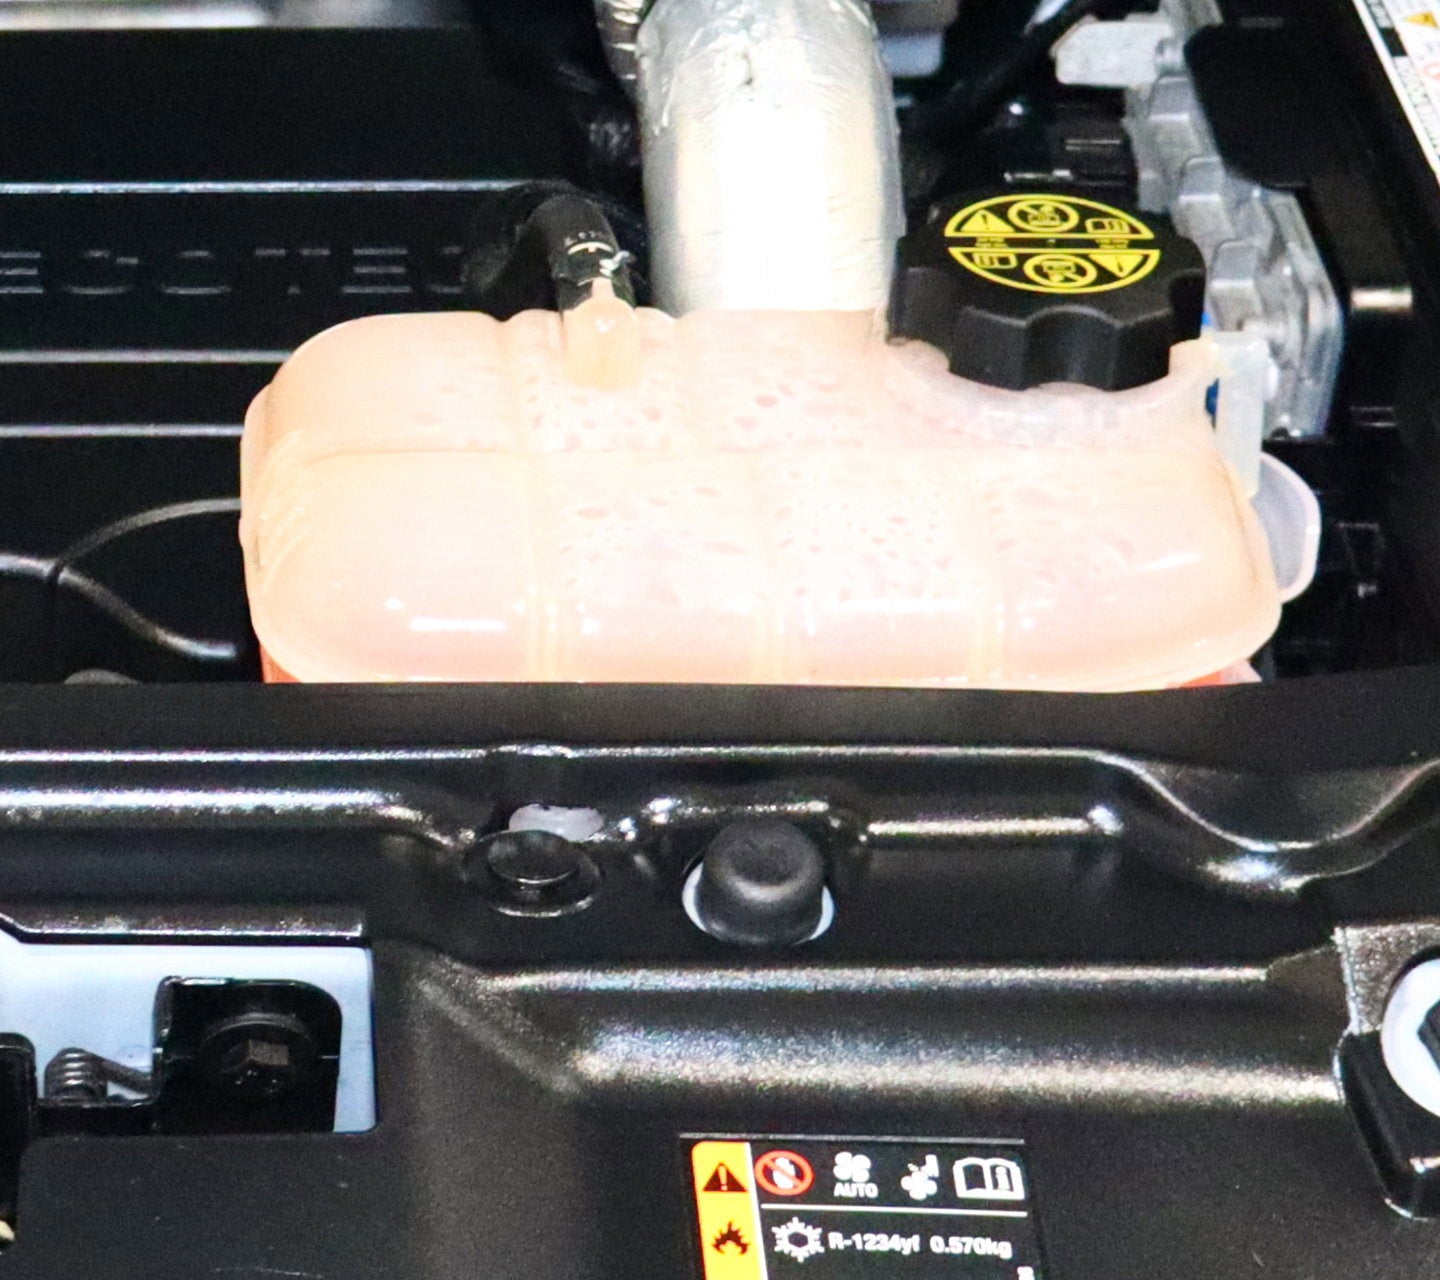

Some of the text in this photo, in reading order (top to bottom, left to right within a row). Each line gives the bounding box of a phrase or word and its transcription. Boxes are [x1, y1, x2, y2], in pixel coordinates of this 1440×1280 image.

[833, 1182, 879, 1198] AUTO
[828, 1231, 1013, 1260] R-1234yf 0.570kg
